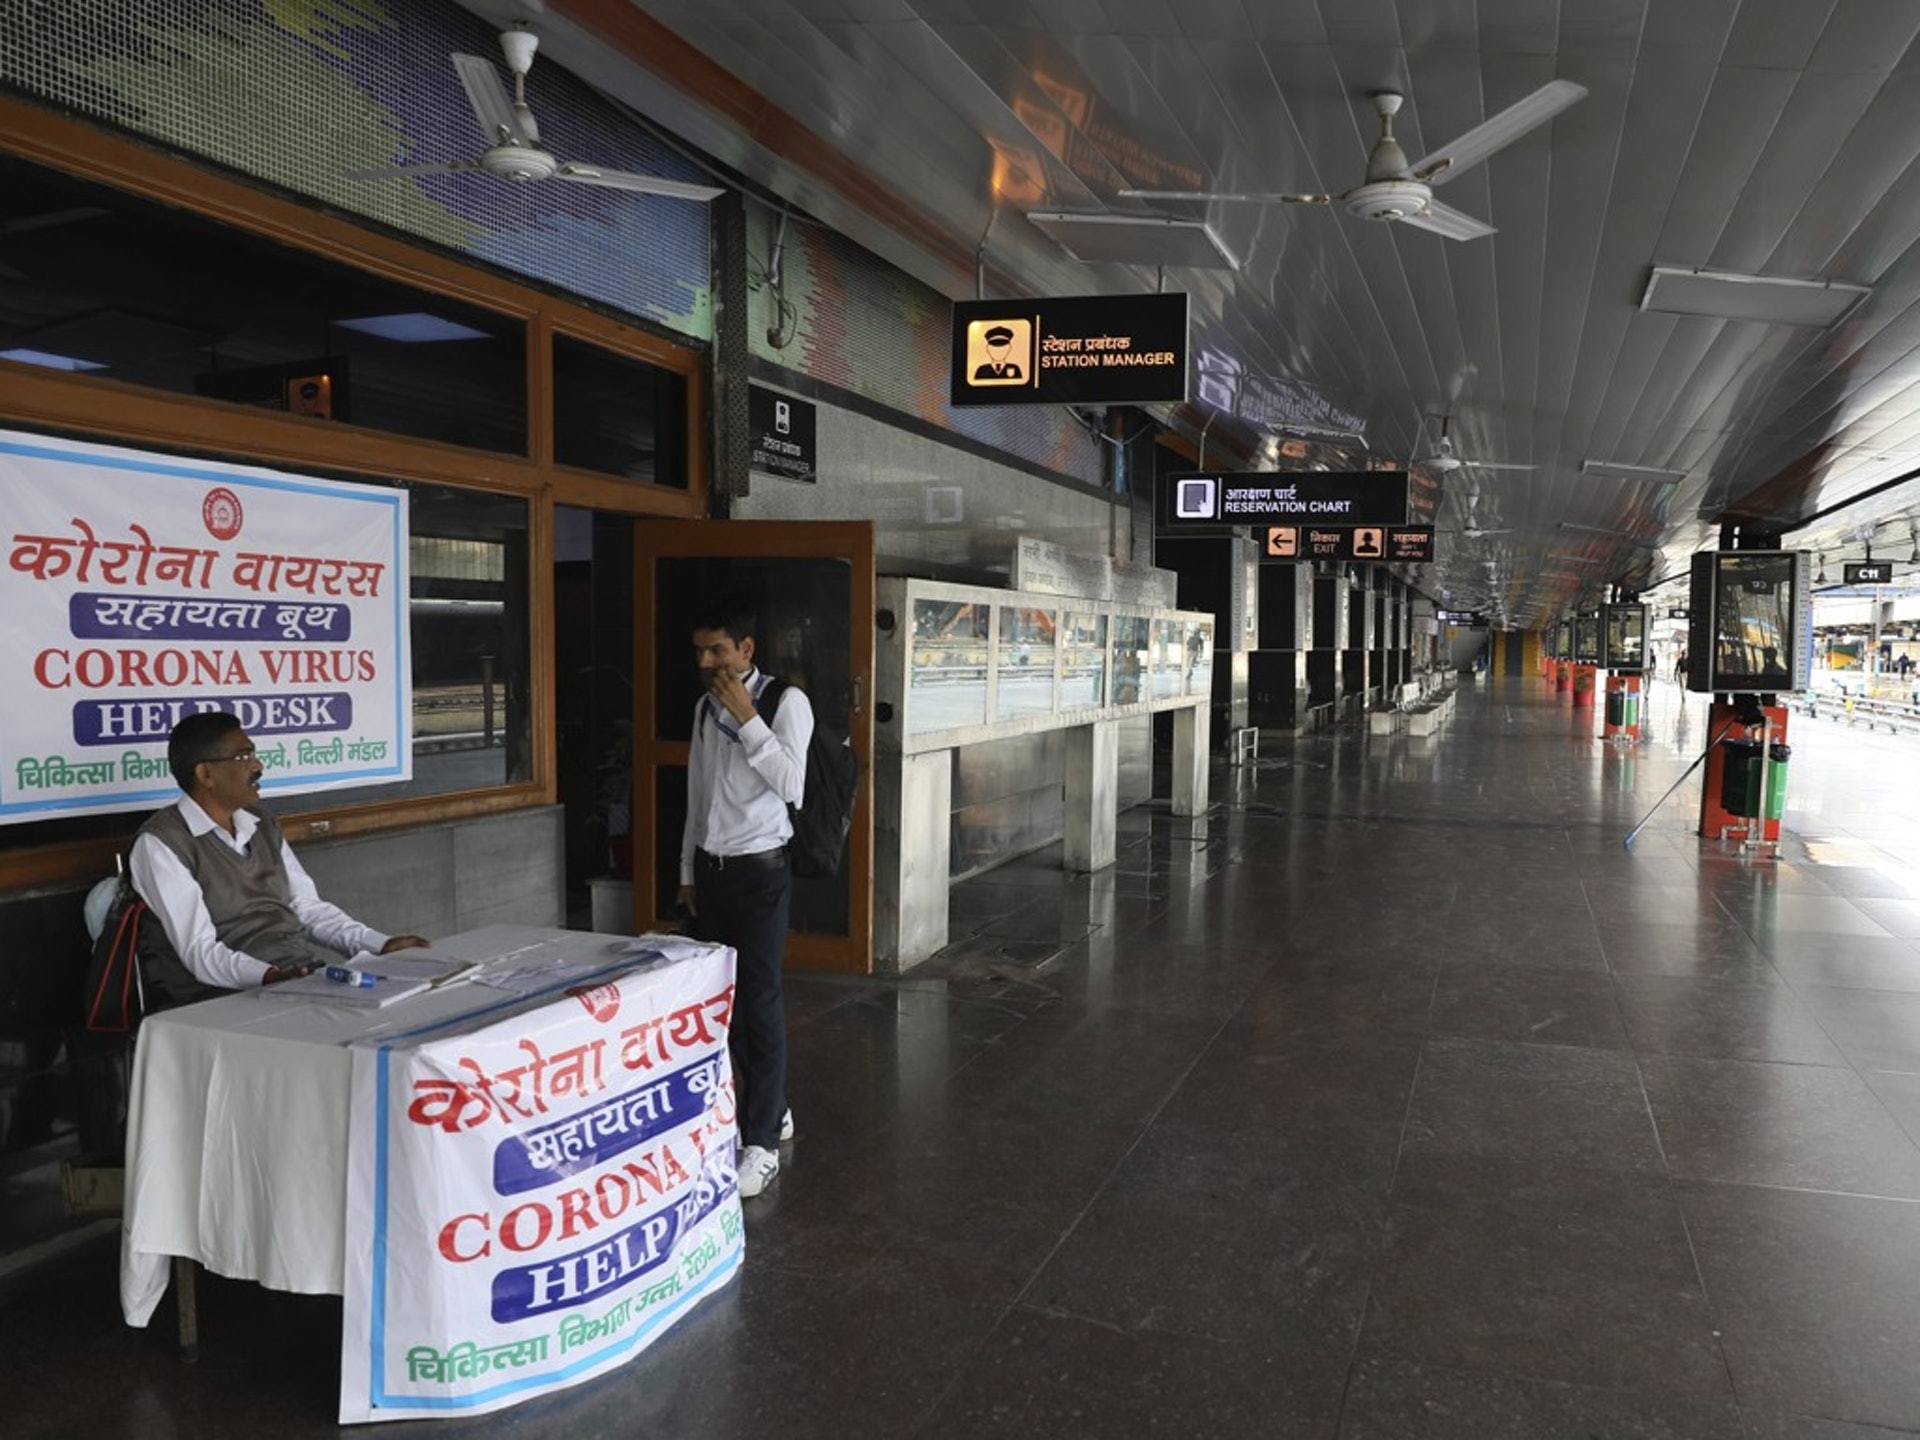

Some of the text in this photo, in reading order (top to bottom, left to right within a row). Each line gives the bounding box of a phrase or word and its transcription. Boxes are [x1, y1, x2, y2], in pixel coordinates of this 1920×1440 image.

[1041, 351, 1175, 368] STATION MANAGER
[1042, 333, 1131, 353] स्टेशन प्रबंधक
[1224, 500, 1351, 513] RESERVATION CHART
[1225, 488, 1272, 501] आरक्षण
[9, 517, 385, 598] कोरोना वायरस
[1313, 543, 1336, 554] EXIT
[95, 597, 338, 640] सहायता बूथ
[33, 647, 376, 689] CORONA VIRUS
[231, 695, 338, 730] DESK
[16, 734, 388, 791] चिकित्सा विभा लवे, दिल्ली मंडल
[407, 983, 736, 1134] कोरोना वायर
[527, 1081, 673, 1170] सहायता
[438, 1144, 691, 1263] CORONA
[526, 1213, 669, 1309] HELP
[406, 1334, 551, 1385] चिकित्सा
[558, 1294, 633, 1355] विभाग
